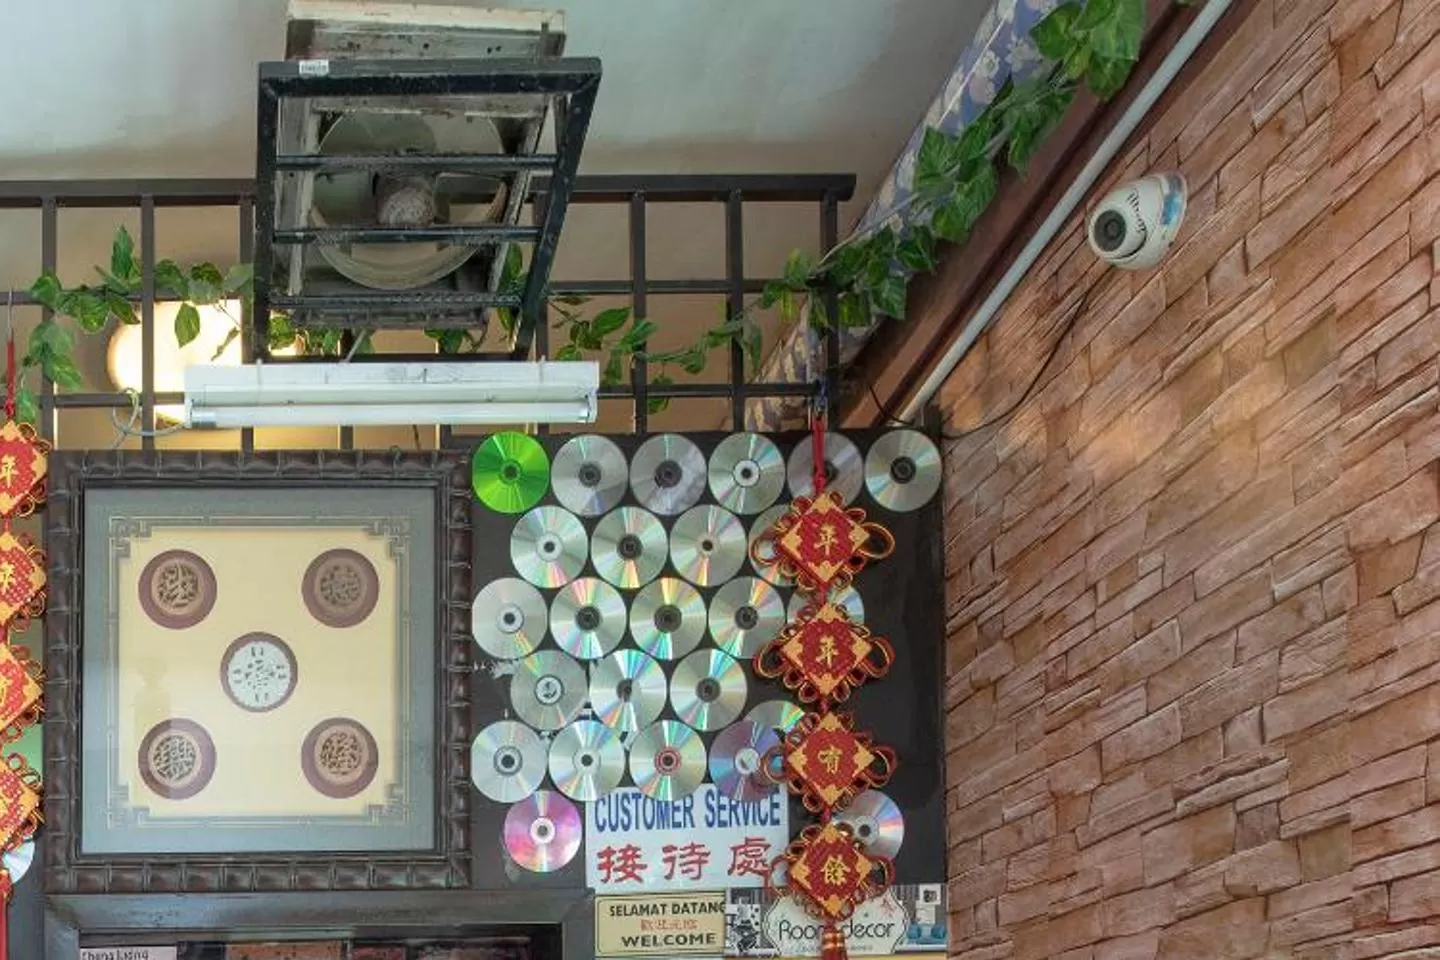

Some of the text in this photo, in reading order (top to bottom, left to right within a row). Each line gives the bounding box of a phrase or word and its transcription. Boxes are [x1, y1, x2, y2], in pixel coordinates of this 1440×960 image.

[595, 790, 780, 832] CUSTOMER SERVICE
[597, 836, 772, 884] 接待處
[610, 904, 667, 917] SELAMAT
[840, 918, 895, 939] decor
[621, 933, 716, 947] WELCOME
